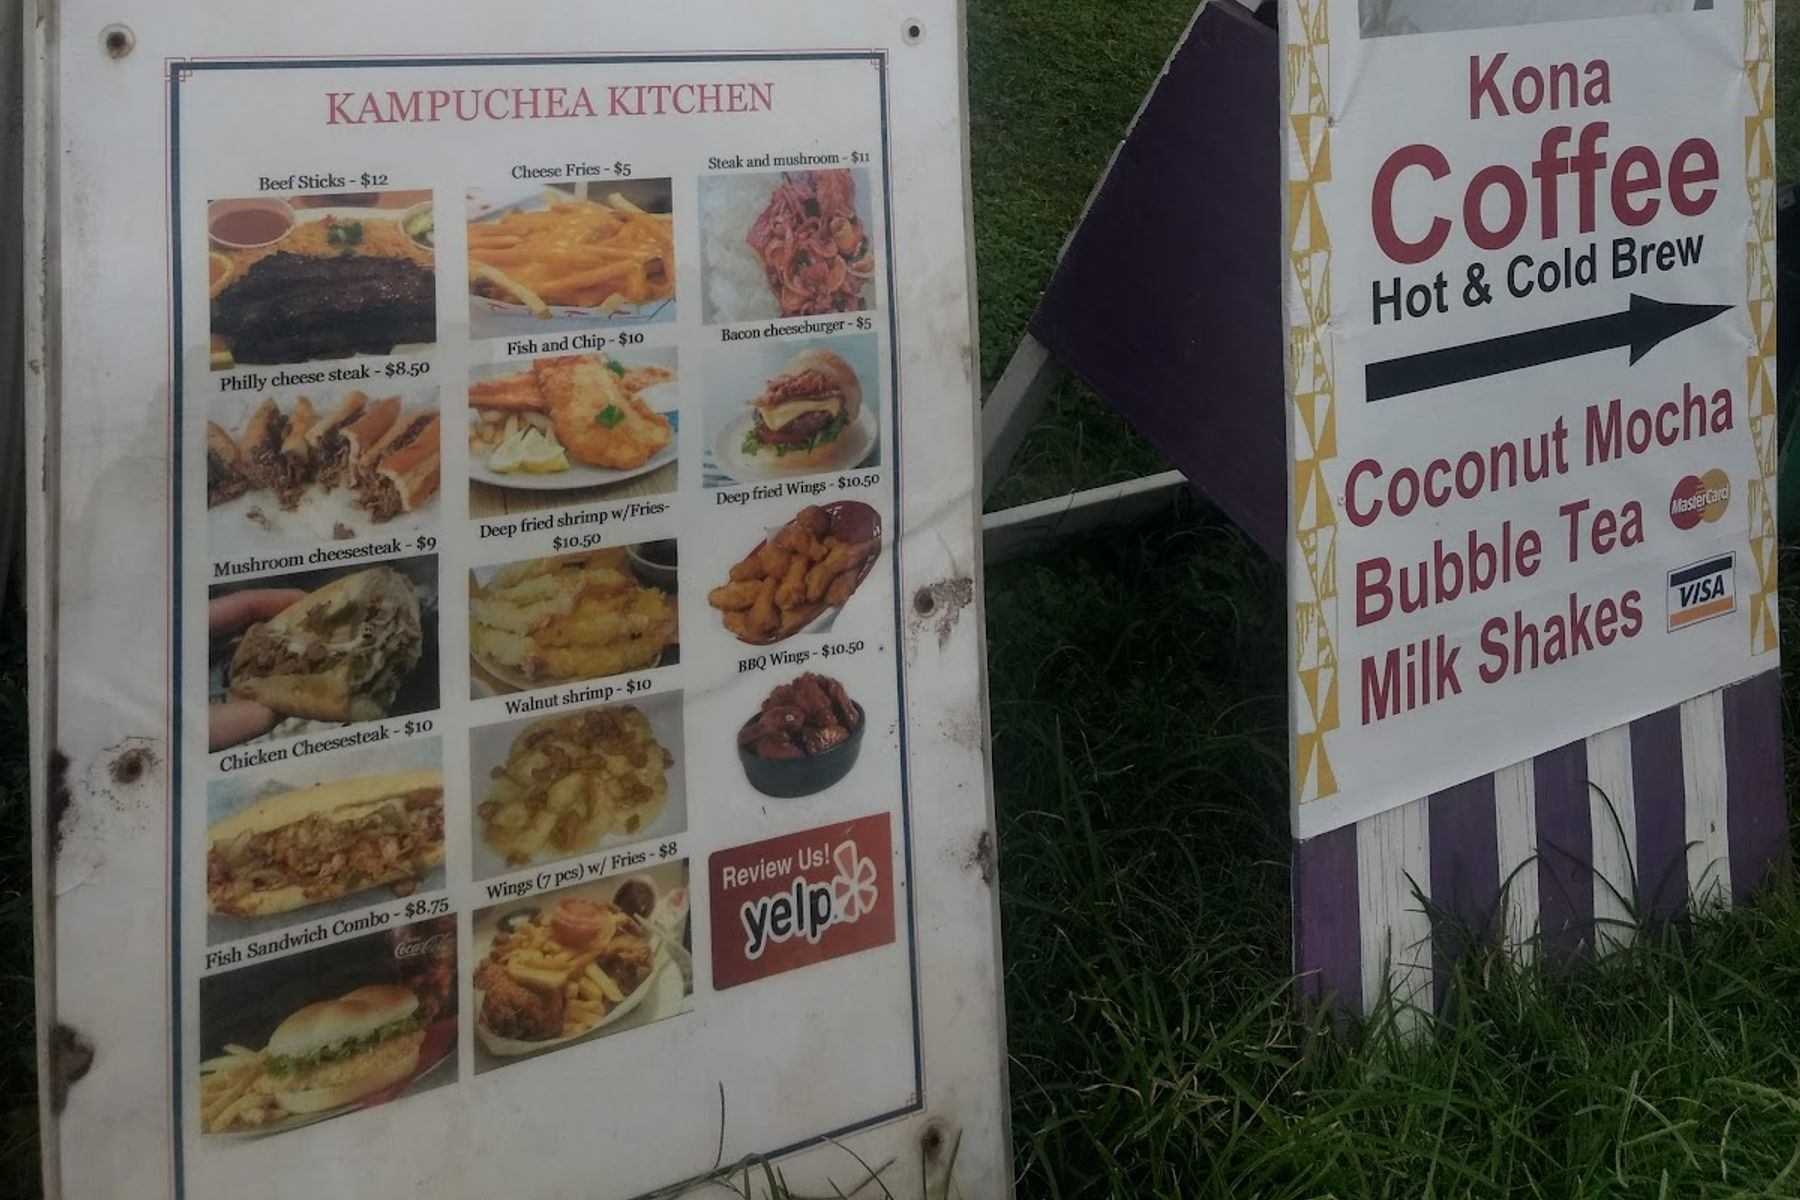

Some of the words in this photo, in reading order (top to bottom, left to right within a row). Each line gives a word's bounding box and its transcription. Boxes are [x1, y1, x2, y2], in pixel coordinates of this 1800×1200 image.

[325, 86, 598, 125] KAMPUCHEA
[607, 83, 775, 117] KITCHEN
[1470, 52, 1611, 119] Kona
[511, 164, 562, 180] Cheese
[566, 162, 601, 177] Fries
[614, 161, 631, 177] $5
[708, 154, 743, 169] Steak
[746, 153, 770, 168] and
[773, 152, 840, 166] mushroom
[851, 150, 870, 163] $11
[258, 175, 295, 191] Beef
[298, 172, 346, 188] Sticks
[360, 172, 389, 188] $12
[1372, 121, 1719, 264] Coffee
[1372, 272, 1448, 325] Hot
[1463, 262, 1493, 308] &
[1507, 243, 1596, 298] Cold
[1612, 235, 1704, 280] Brew
[506, 340, 538, 356] Fish
[541, 337, 569, 353] and
[572, 334, 606, 354] Chip
[619, 332, 644, 347] $10
[721, 325, 760, 342] Bacon
[763, 318, 845, 340] cheeseburger
[856, 316, 871, 331] $5
[220, 373, 267, 392] Philly
[271, 368, 325, 387] cheese
[328, 364, 370, 382] steak
[385, 362, 430, 378] $8.50
[1345, 415, 1569, 527] Coconut
[1585, 382, 1733, 466] Mocha
[716, 489, 750, 506] Deep
[752, 483, 783, 500] fried
[786, 479, 826, 498] Wings
[838, 473, 880, 490] $10.50
[1671, 484, 1729, 517] MasterCard
[480, 521, 518, 541] Deep
[521, 514, 555, 533] fried
[557, 509, 608, 531] shrimp
[553, 532, 601, 552] $10.50
[213, 553, 304, 577] Mushroom
[308, 539, 401, 564] cheesesteak
[416, 536, 437, 551] $9
[1356, 521, 1542, 627] Bubble
[1559, 499, 1644, 562] Tea
[1680, 574, 1725, 608] VISA
[738, 657, 767, 674] BBQ
[770, 650, 811, 669] Wings
[822, 640, 865, 658] $10.50
[1361, 634, 1462, 725] Milk
[1478, 590, 1643, 684] Shakes
[505, 693, 559, 715] Walnut
[562, 686, 614, 706] shrimp
[626, 678, 652, 694] $10
[219, 748, 288, 773] Chicken
[292, 726, 389, 758] Cheesesteak
[404, 719, 433, 737] $10
[486, 877, 533, 900] Wings
[536, 872, 552, 889] (7
[555, 863, 585, 886] pcs)
[587, 857, 606, 876] w/
[611, 850, 647, 868] Fries
[658, 841, 678, 860] $8
[722, 858, 792, 890] Review
[797, 843, 830, 870] Us!
[204, 947, 242, 971] Fish
[247, 924, 327, 959] Sandwich
[332, 911, 389, 937] Combo
[405, 897, 449, 920] $8.75
[744, 883, 832, 954] yelp
